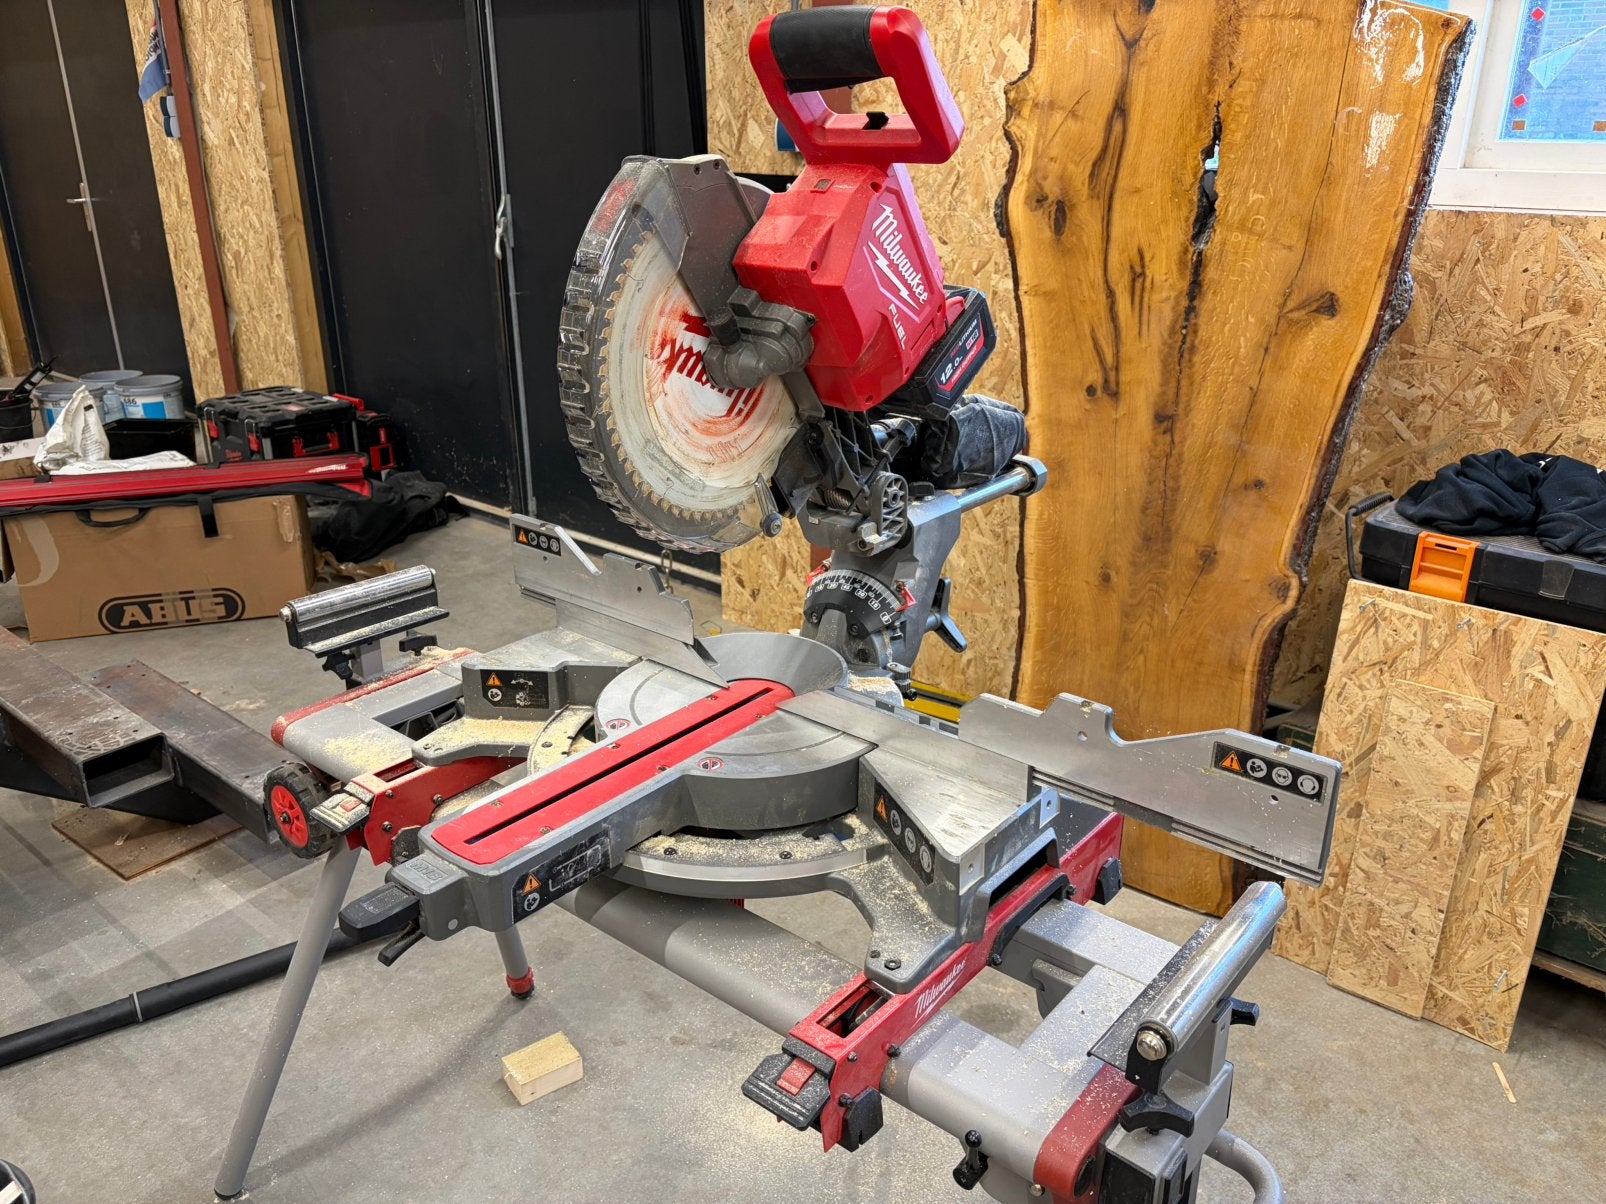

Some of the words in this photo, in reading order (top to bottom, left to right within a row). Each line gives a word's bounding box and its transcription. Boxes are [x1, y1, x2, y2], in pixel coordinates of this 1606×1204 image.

[872, 203, 928, 304] Milwaukee
[889, 303, 907, 350] FUEL
[914, 959, 967, 1018] Milwaukee
